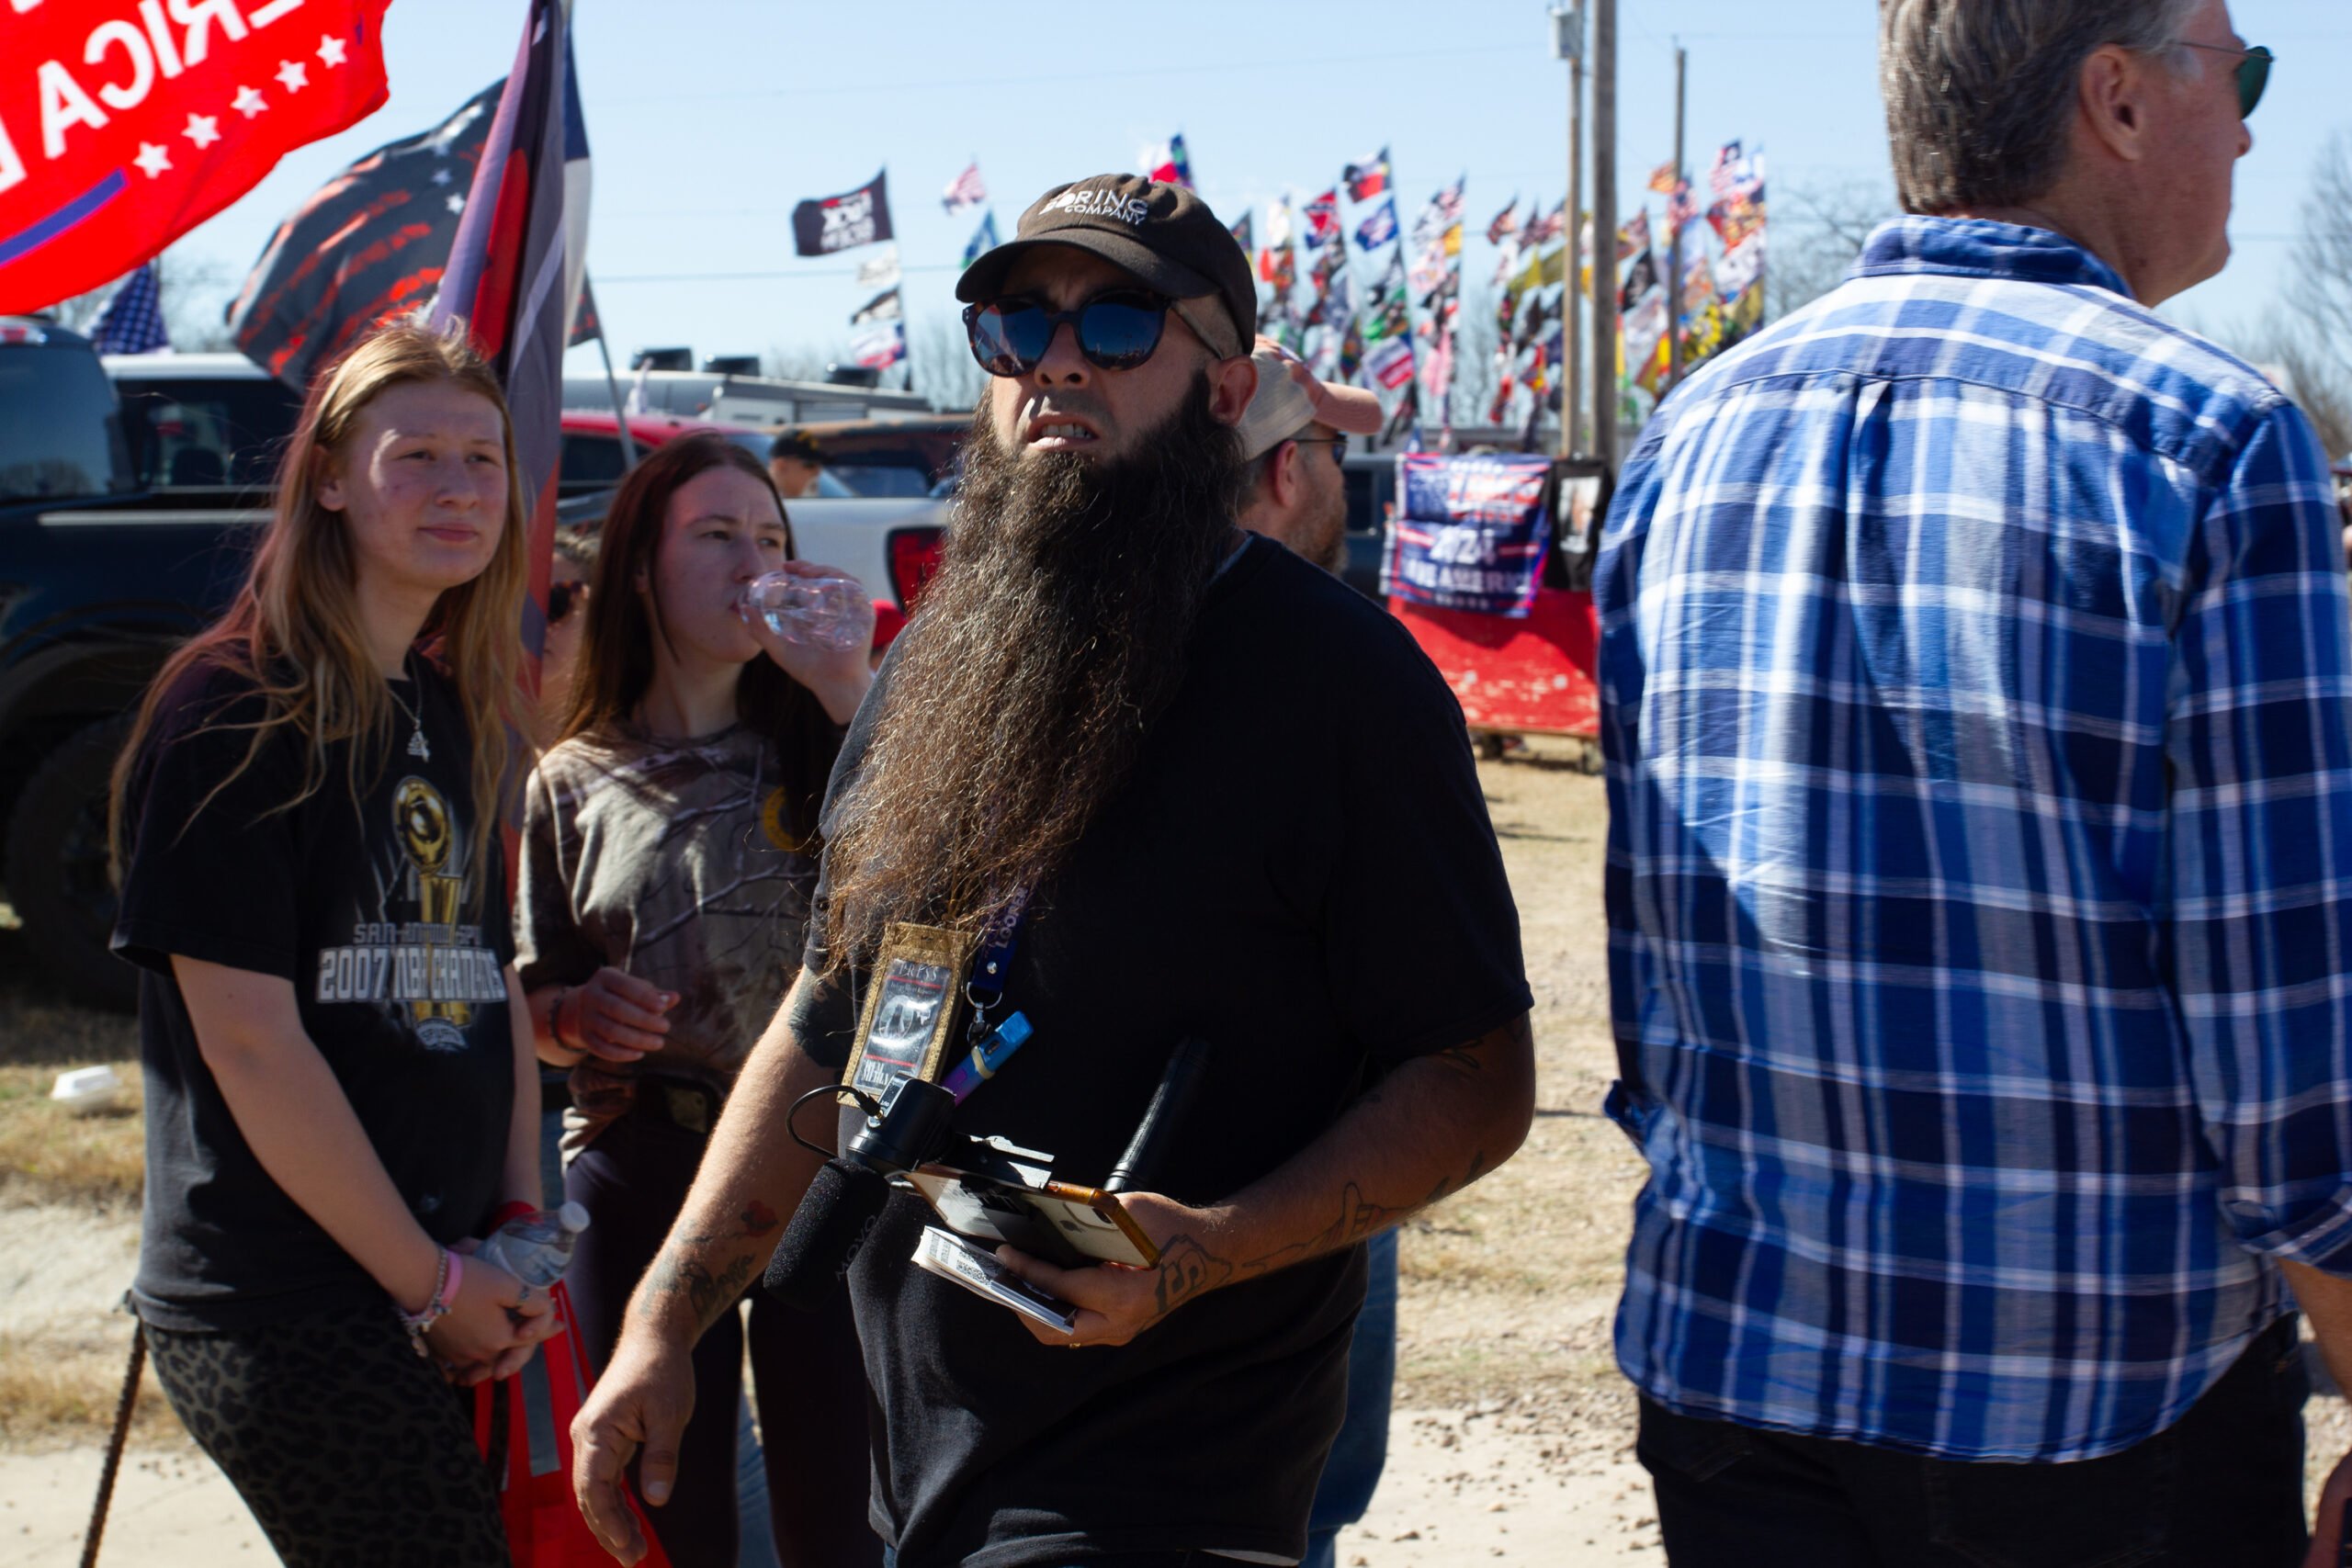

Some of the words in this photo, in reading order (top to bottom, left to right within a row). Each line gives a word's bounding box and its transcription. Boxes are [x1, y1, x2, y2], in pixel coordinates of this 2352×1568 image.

[1064, 203, 1146, 226] COMPANY
[354, 921, 397, 945] SAN
[316, 946, 390, 1003] 2007
[897, 964, 938, 980] PRESS
